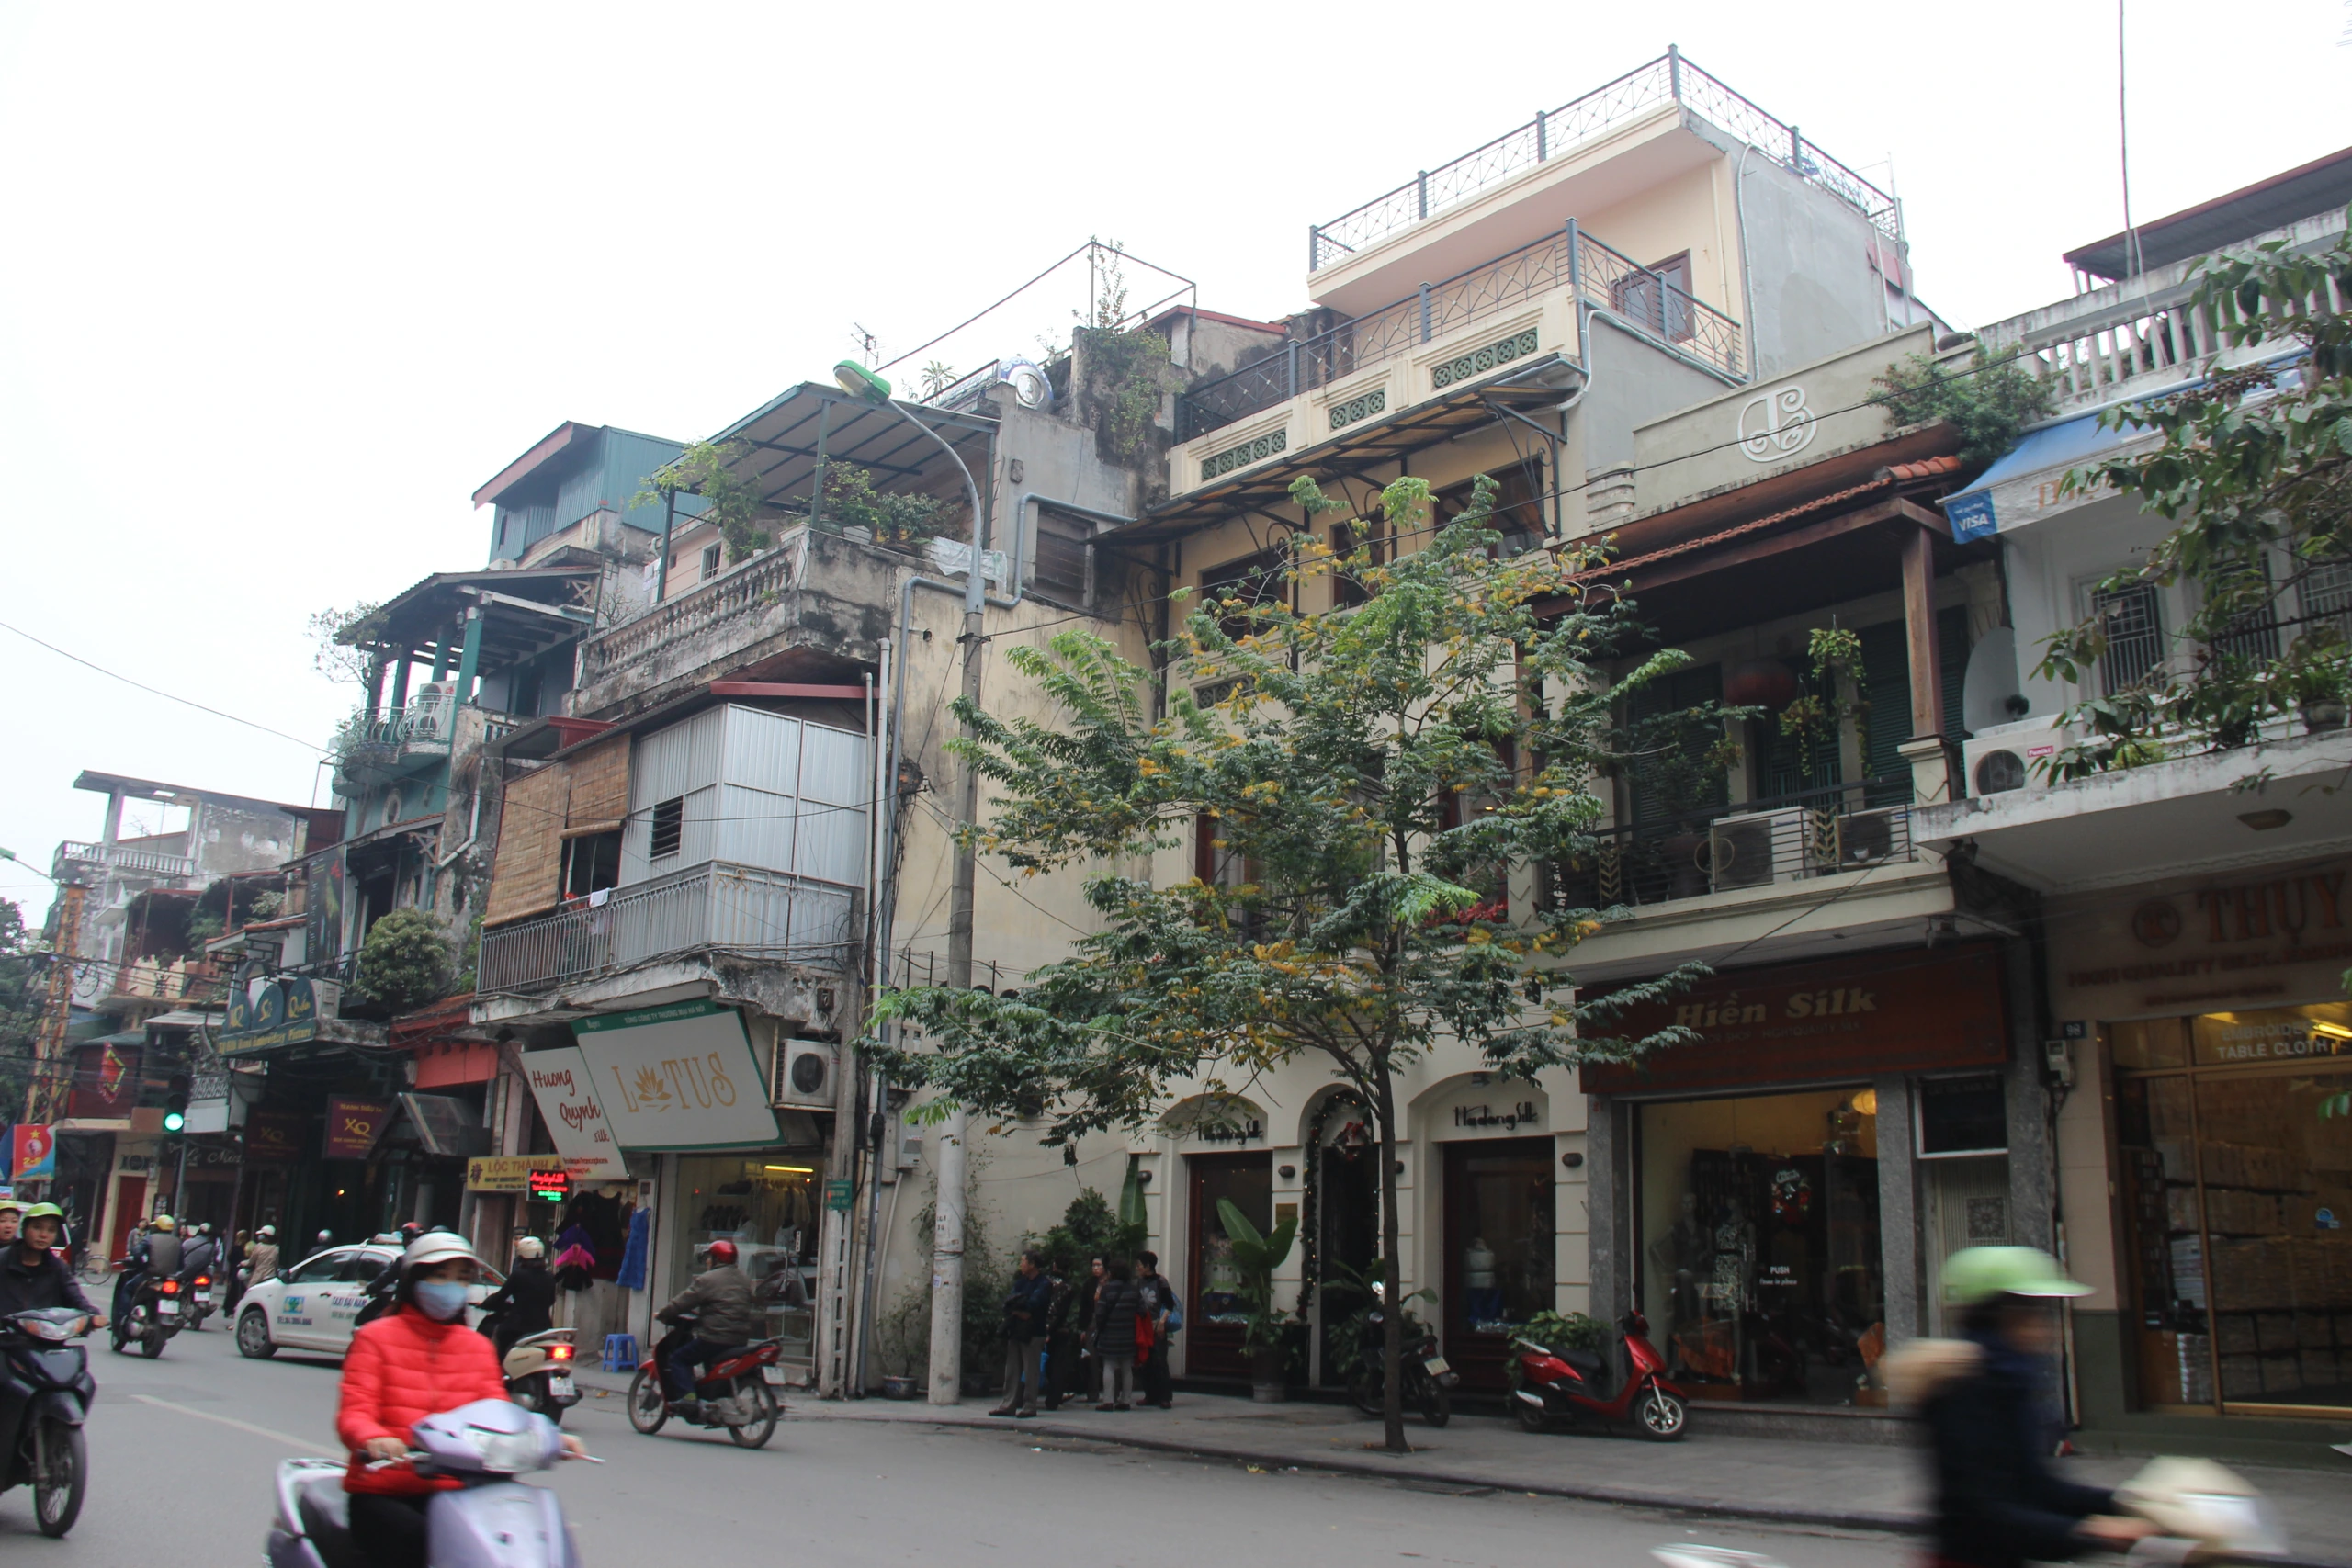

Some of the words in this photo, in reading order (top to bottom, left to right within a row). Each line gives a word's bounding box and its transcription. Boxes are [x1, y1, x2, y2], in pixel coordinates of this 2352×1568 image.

[1957, 513, 1990, 532] VISA
[2027, 747, 2052, 758] Funiki
[2196, 871, 2347, 945] THỤY
[1675, 991, 1766, 1029] Hiền
[1785, 987, 1877, 1019] Silk
[2216, 1043, 2268, 1059] TABLE
[2274, 1039, 2329, 1055] CLOTH
[344, 1118, 373, 1139] XQ
[1770, 1265, 1791, 1275] PUSH
